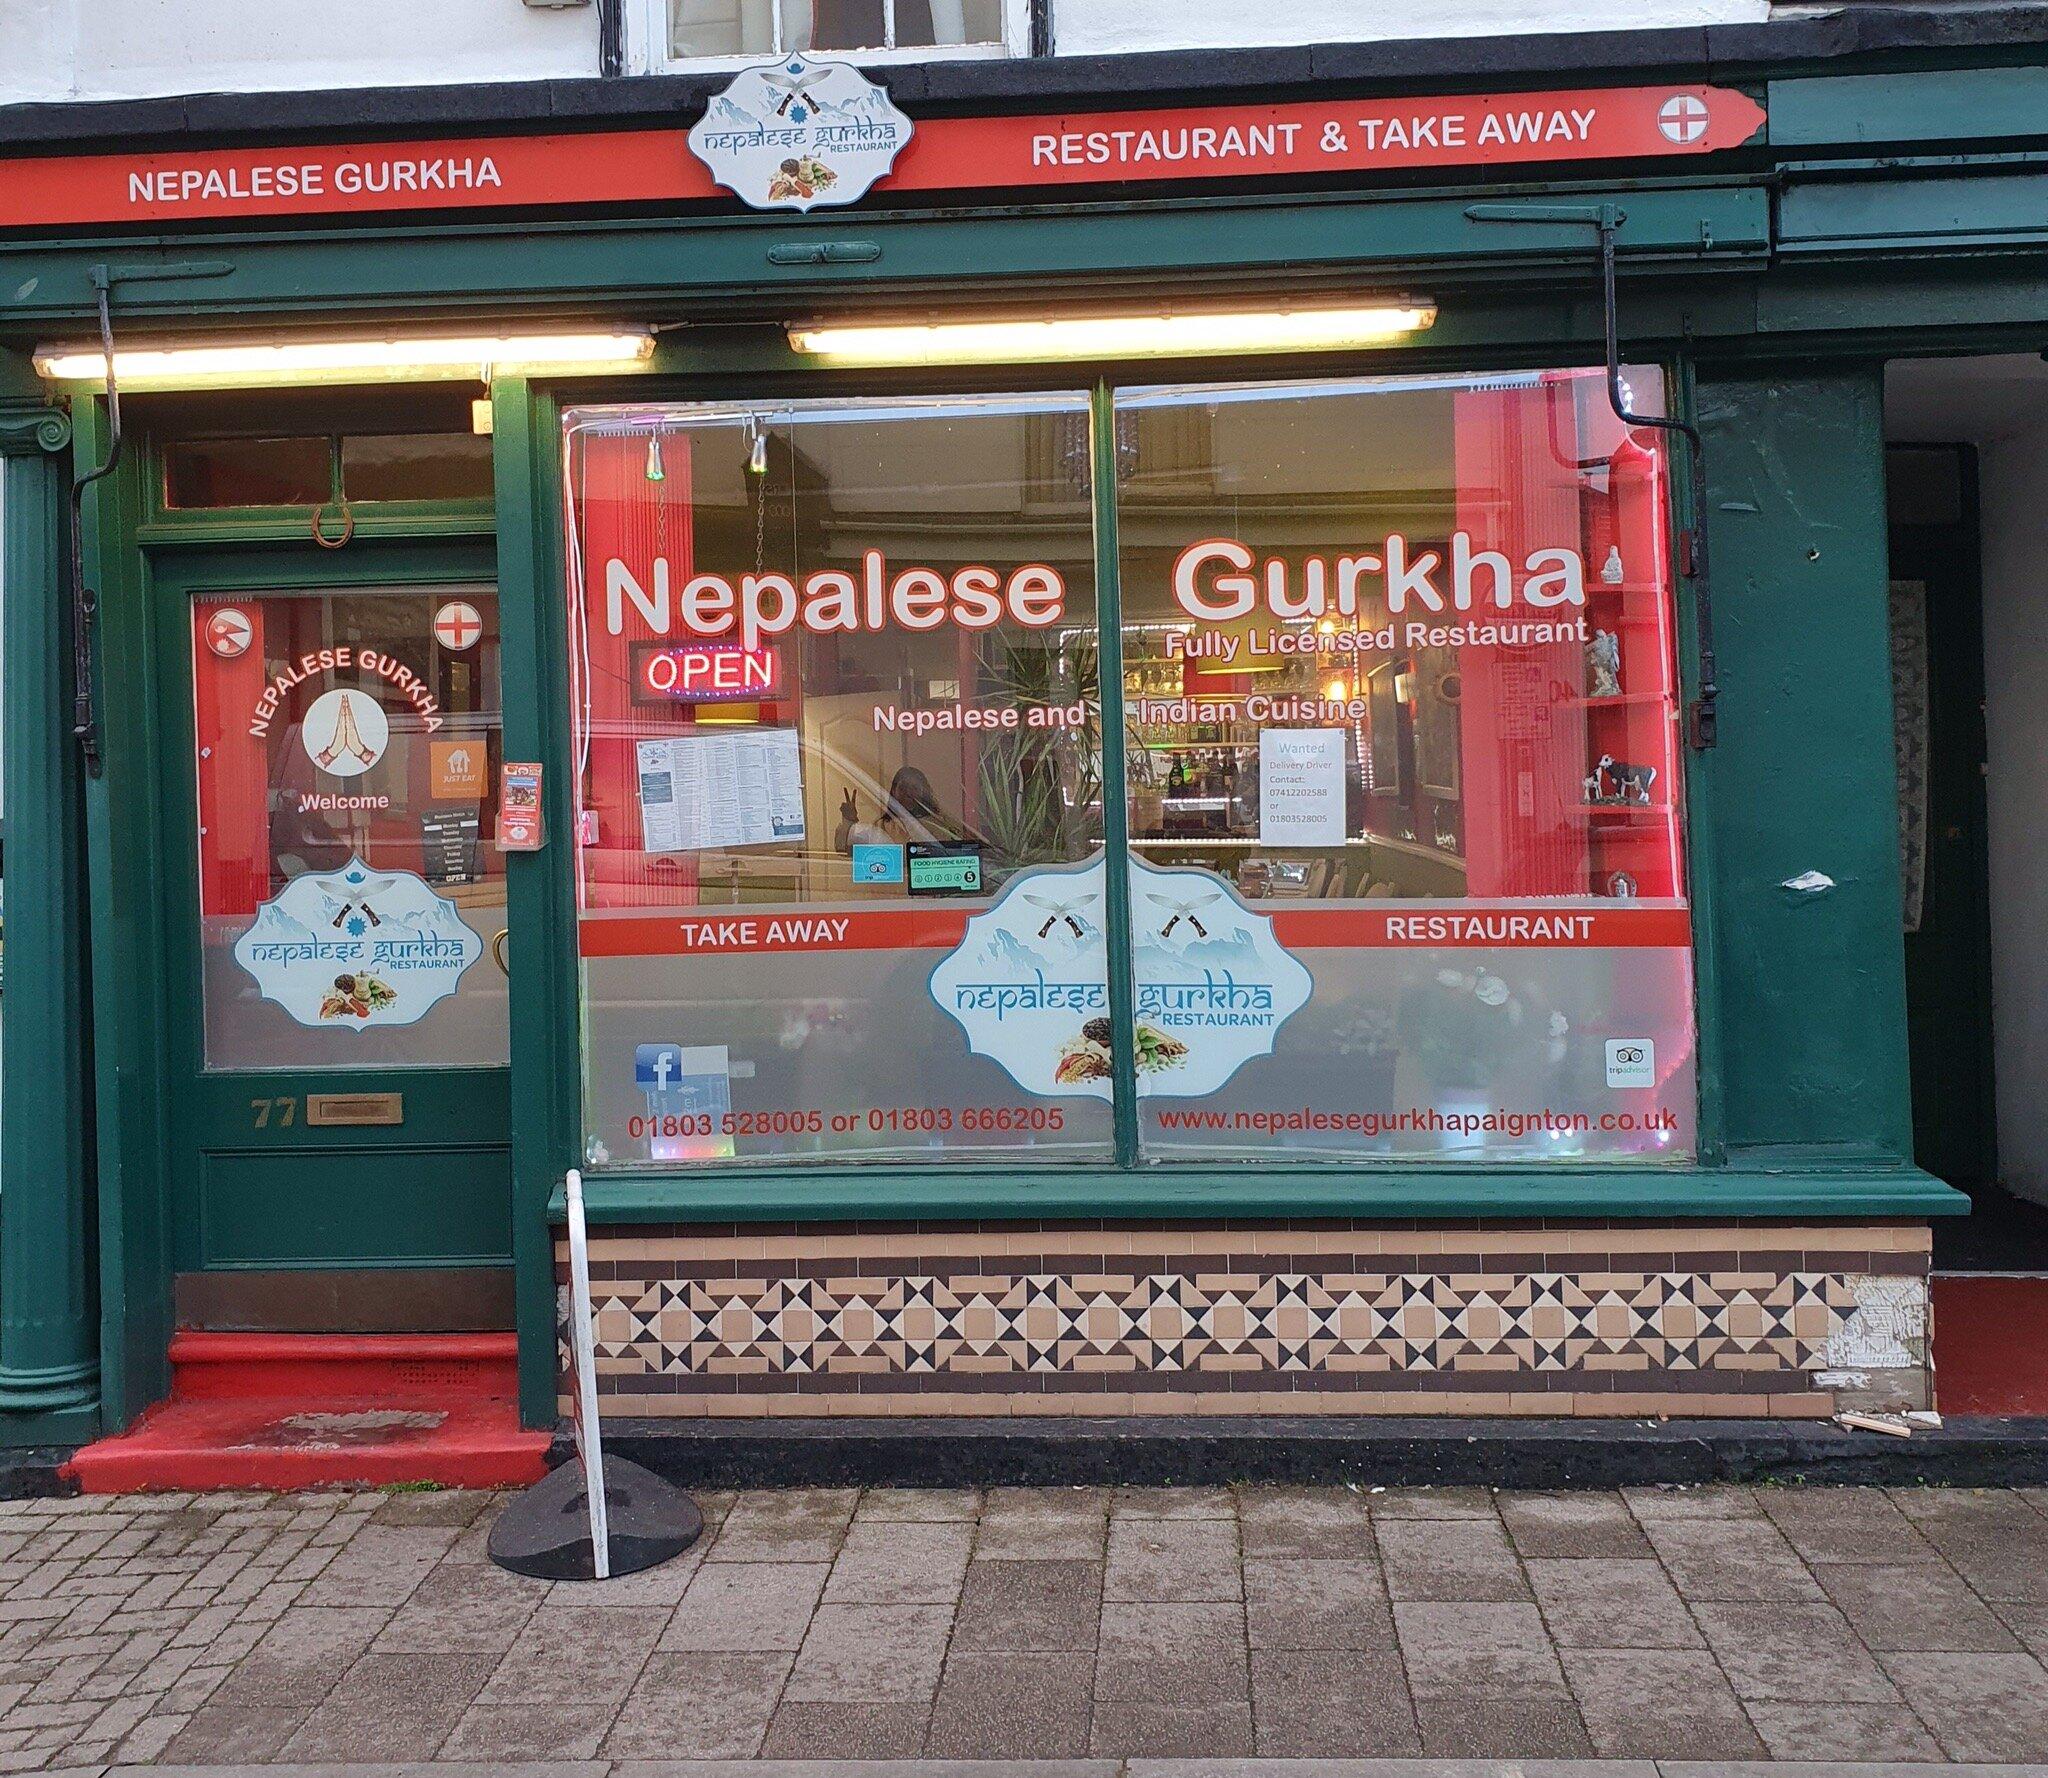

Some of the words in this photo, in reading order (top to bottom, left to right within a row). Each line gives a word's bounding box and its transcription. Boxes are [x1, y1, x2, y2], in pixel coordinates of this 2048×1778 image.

[704, 120, 807, 156] nepalese
[813, 115, 897, 150] gurkha
[830, 140, 898, 154] RESTAURANT
[1032, 122, 1302, 167] RESTAURANT
[1320, 121, 1349, 154] &
[1357, 114, 1467, 151] TAKE
[1476, 107, 1597, 146] AWAY
[128, 164, 324, 203] NEPALESE
[334, 156, 503, 194] GURKHA
[605, 551, 1063, 653] Nepalese
[1174, 530, 1587, 622] Gurkha
[1165, 629, 1238, 663] Fully
[1248, 623, 1395, 656] Licensed
[1406, 617, 1589, 649] Restaurant
[648, 651, 773, 691] OPEN
[249, 647, 352, 738] NEPALESE
[359, 650, 444, 734] GURKHA
[873, 704, 1018, 736] Nepalese
[1027, 700, 1086, 727] and
[1139, 697, 1237, 724] Indian
[1246, 695, 1367, 722] Cuisine
[1279, 743, 1325, 754] Wanted
[443, 775, 460, 783] JUST
[461, 774, 476, 782] EAT
[1269, 761, 1304, 771] Delivery
[1306, 761, 1332, 769] Driver
[1269, 776, 1305, 784] Contact:
[302, 793, 389, 810] Welcome
[1269, 814, 1328, 823] 01803528005
[446, 874, 466, 882] OPEN
[680, 922, 758, 947] TAKE
[764, 918, 850, 944] AWAY
[1386, 915, 1595, 941] RESTAURANT
[252, 932, 365, 968] nepalese
[370, 929, 465, 966] gurkha
[390, 958, 466, 970] RESTAURANT
[956, 968, 1106, 1021] nepalese
[1135, 968, 1273, 1019] gurkha
[1162, 1013, 1275, 1026] RESTAURANT
[250, 1096, 296, 1129] 77
[627, 1113, 713, 1139] 01803
[721, 1109, 824, 1137] 528005
[830, 1115, 861, 1135] or
[867, 1110, 953, 1134] 01803
[962, 1107, 1065, 1132] 666205
[1157, 1107, 1678, 1139] www.nepalesegurkhapaignton.co.uk
